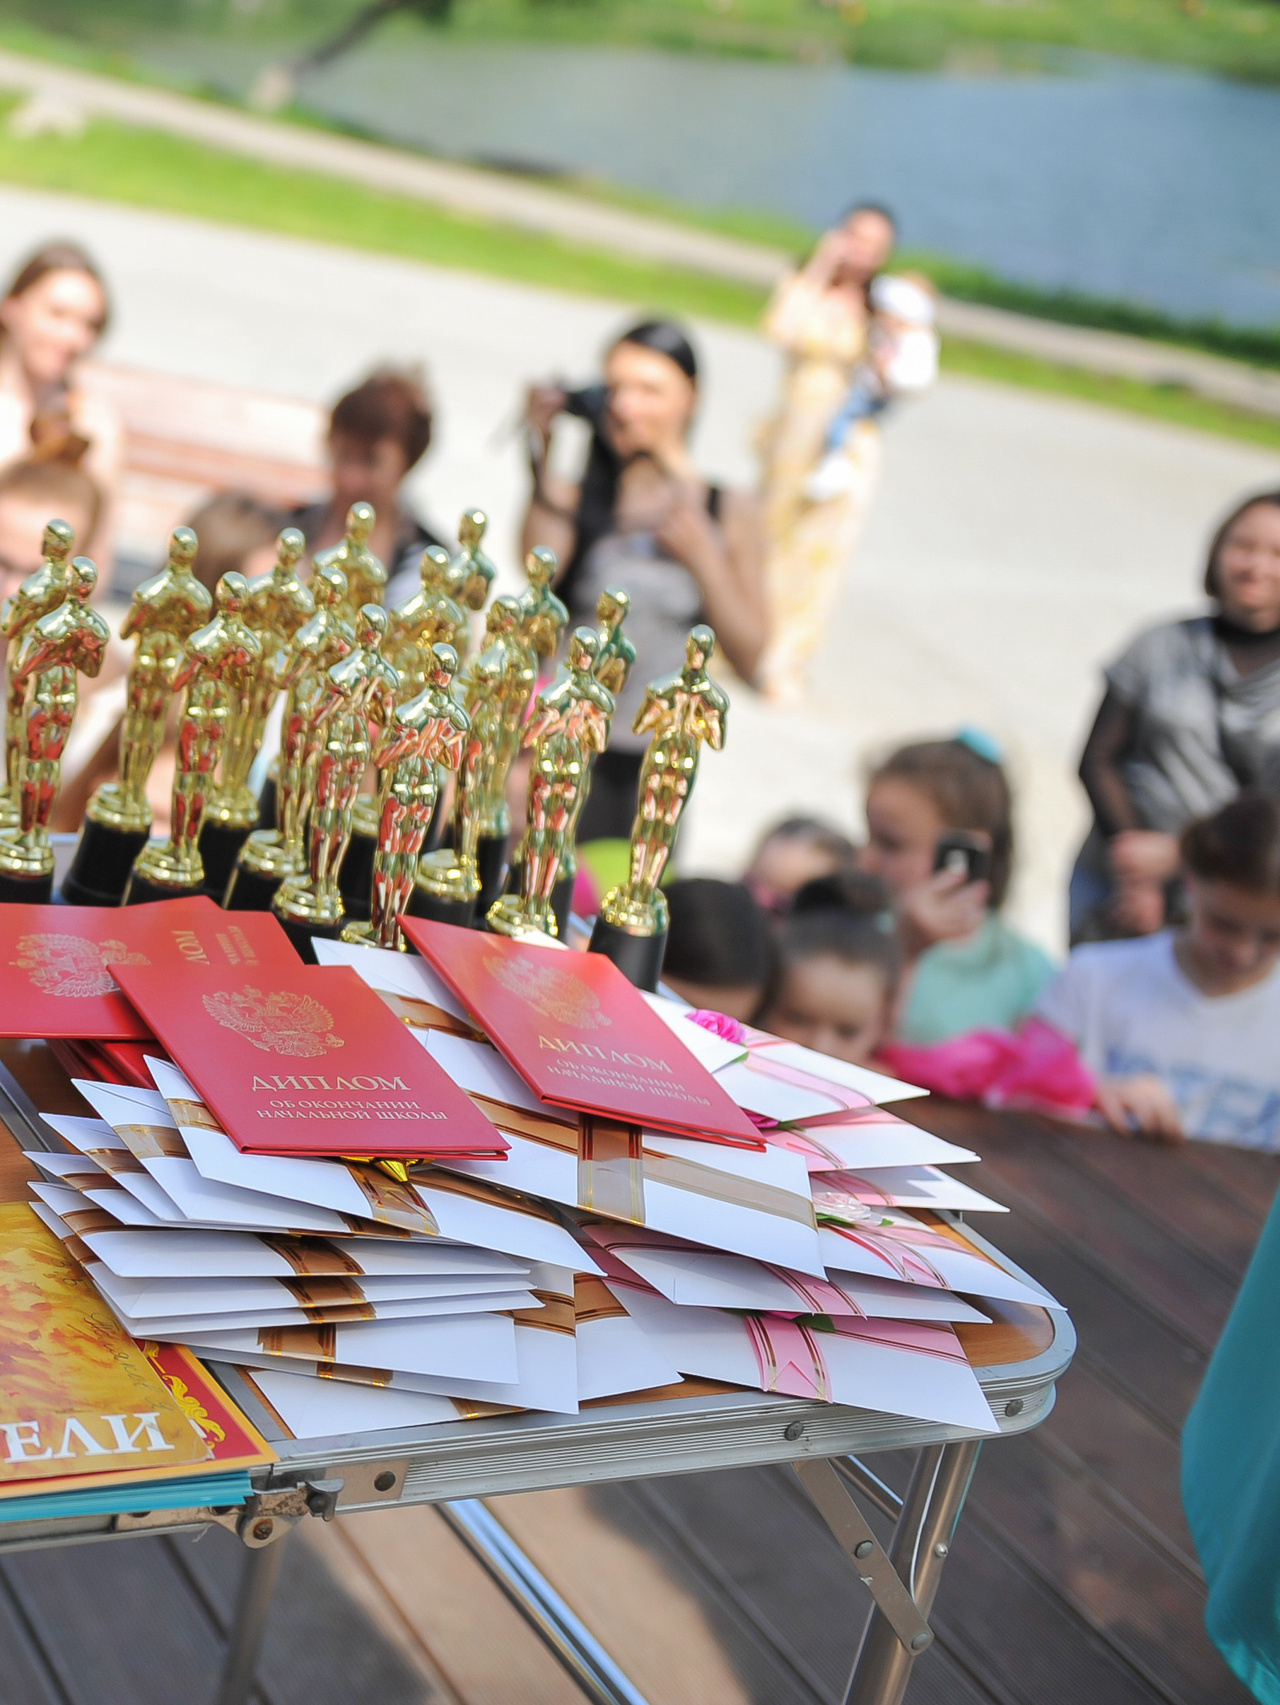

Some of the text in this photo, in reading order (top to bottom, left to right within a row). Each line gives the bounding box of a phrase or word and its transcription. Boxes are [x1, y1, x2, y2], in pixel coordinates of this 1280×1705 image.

[538, 1034, 674, 1074] ДИПЛОМ
[251, 1075, 412, 1093] ДИПЛОМ
[546, 1064, 713, 1107] НАЧАЛЬНОЙ ШКОЛЫ
[556, 1059, 687, 1092] ОБ ОКОНЧАНИИ
[256, 1109, 449, 1121] НАЧАЛЬНОЙ ШКОЛЫ
[269, 1099, 421, 1110] ОБ ОКОНЧАНИИ
